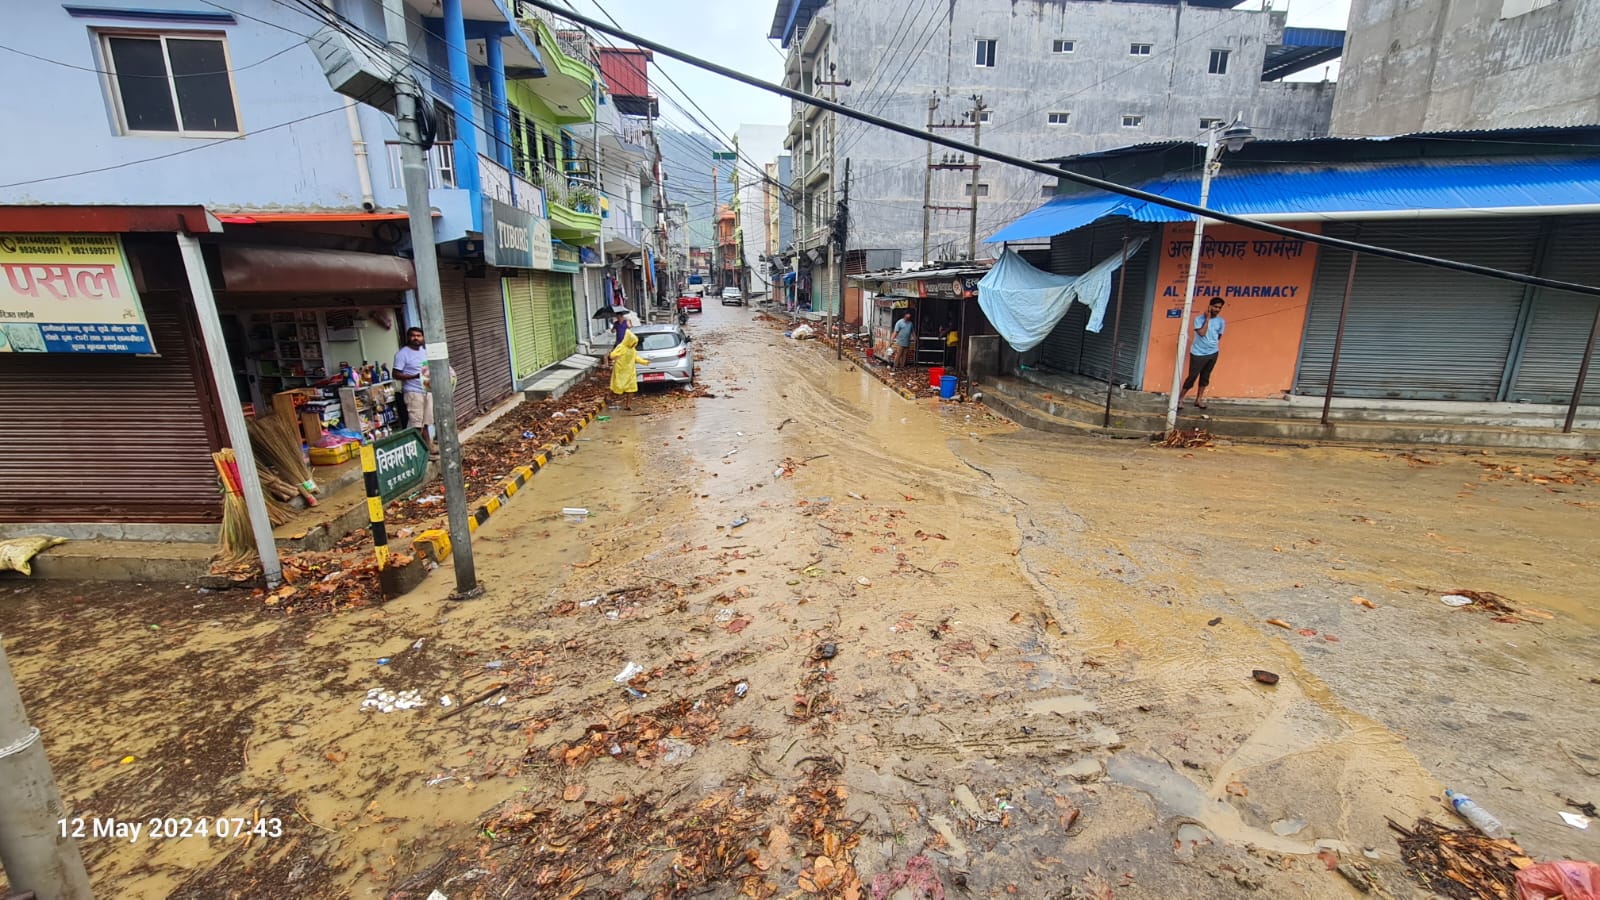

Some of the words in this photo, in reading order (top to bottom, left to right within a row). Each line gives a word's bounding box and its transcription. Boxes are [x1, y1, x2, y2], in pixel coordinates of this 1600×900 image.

[497, 221, 529, 253] TUBORG
[0, 263, 121, 301] पसल
[1163, 285, 1179, 297] AL
[1225, 285, 1299, 298] PHARMACY
[376, 445, 406, 474] विकास
[405, 440, 418, 460] पथ
